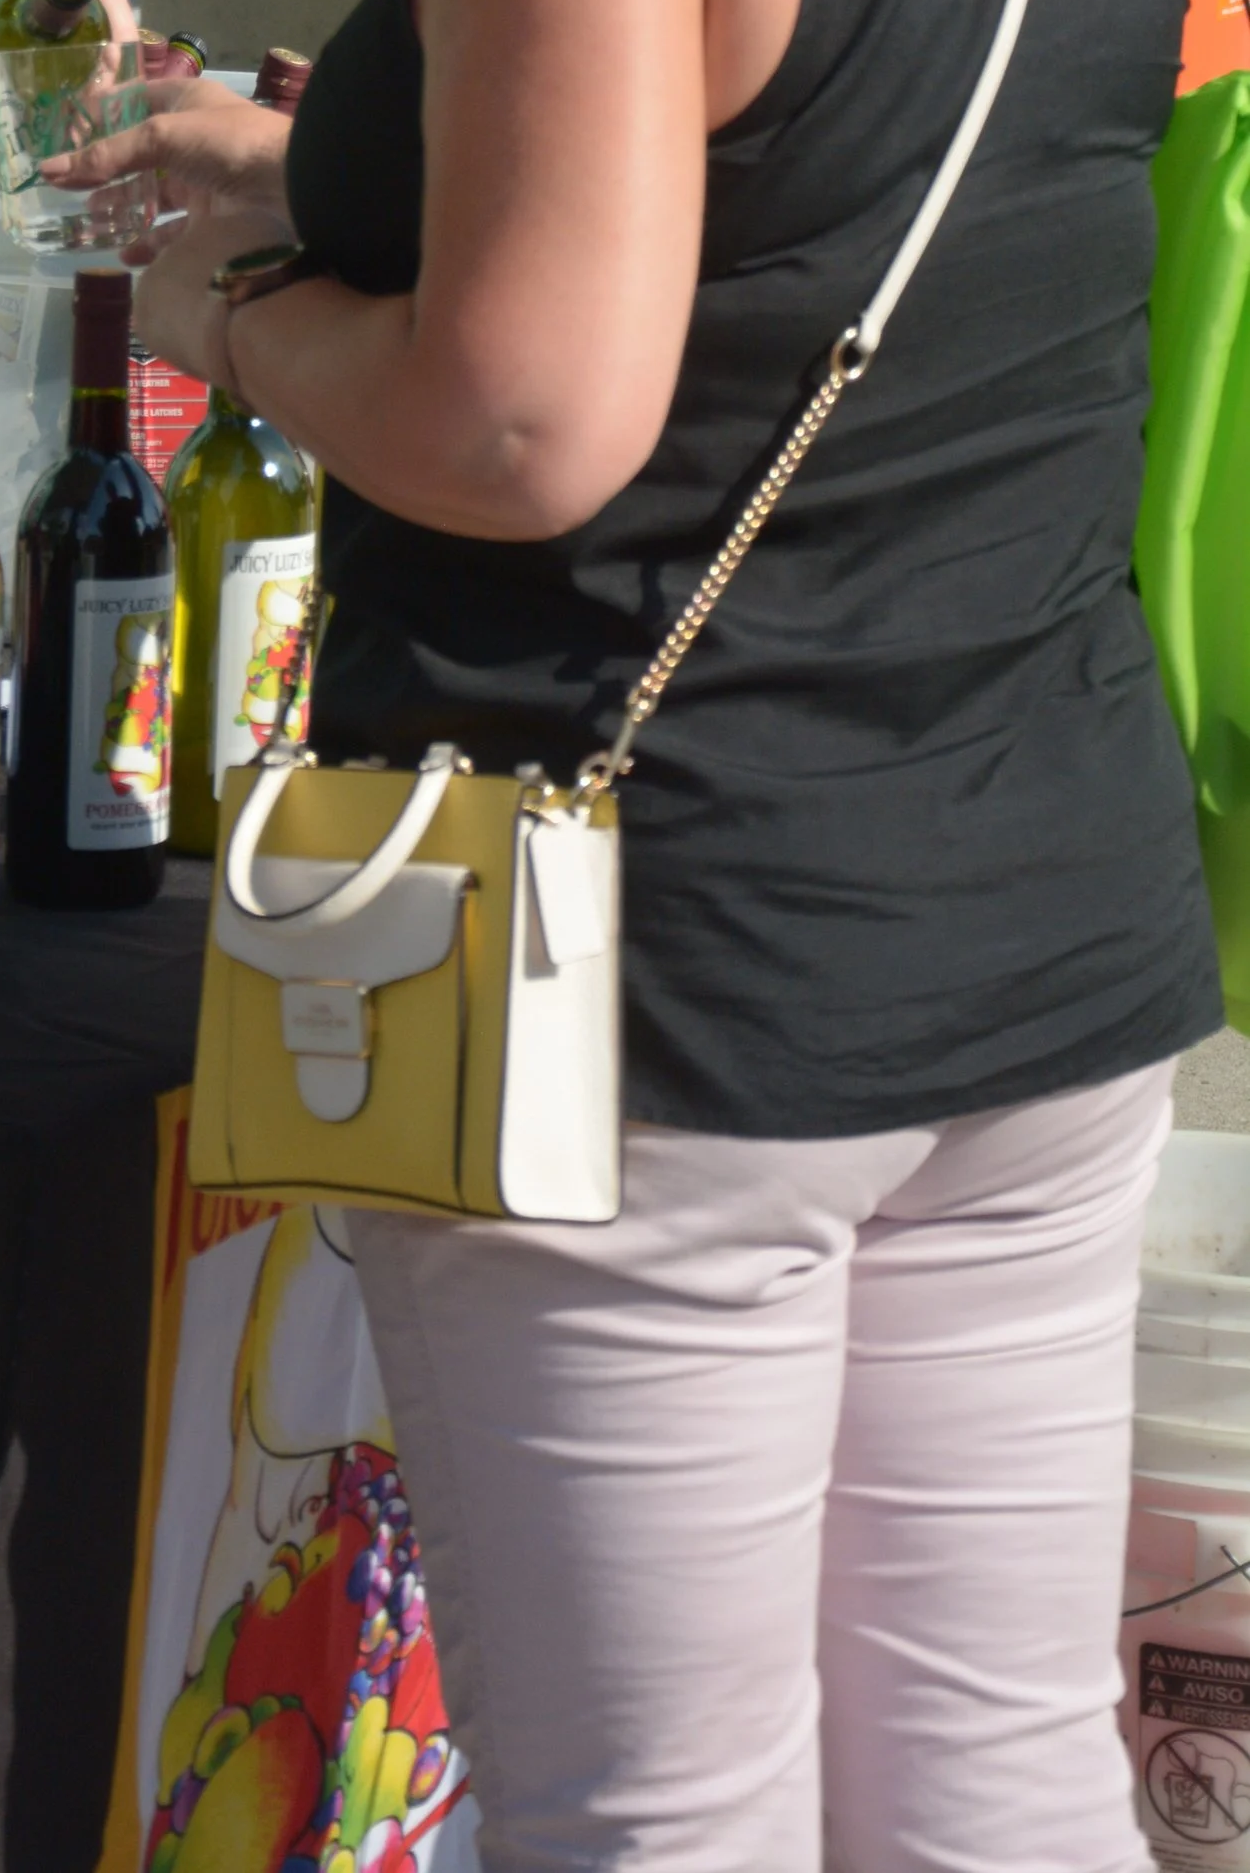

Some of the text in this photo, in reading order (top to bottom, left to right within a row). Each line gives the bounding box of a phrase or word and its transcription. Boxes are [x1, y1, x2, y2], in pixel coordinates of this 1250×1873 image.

[230, 552, 272, 574] JUICY
[78, 598, 127, 614] JUICY
[1167, 1654, 1250, 1680] WARNIN
[1183, 1682, 1244, 1704] AVISO
